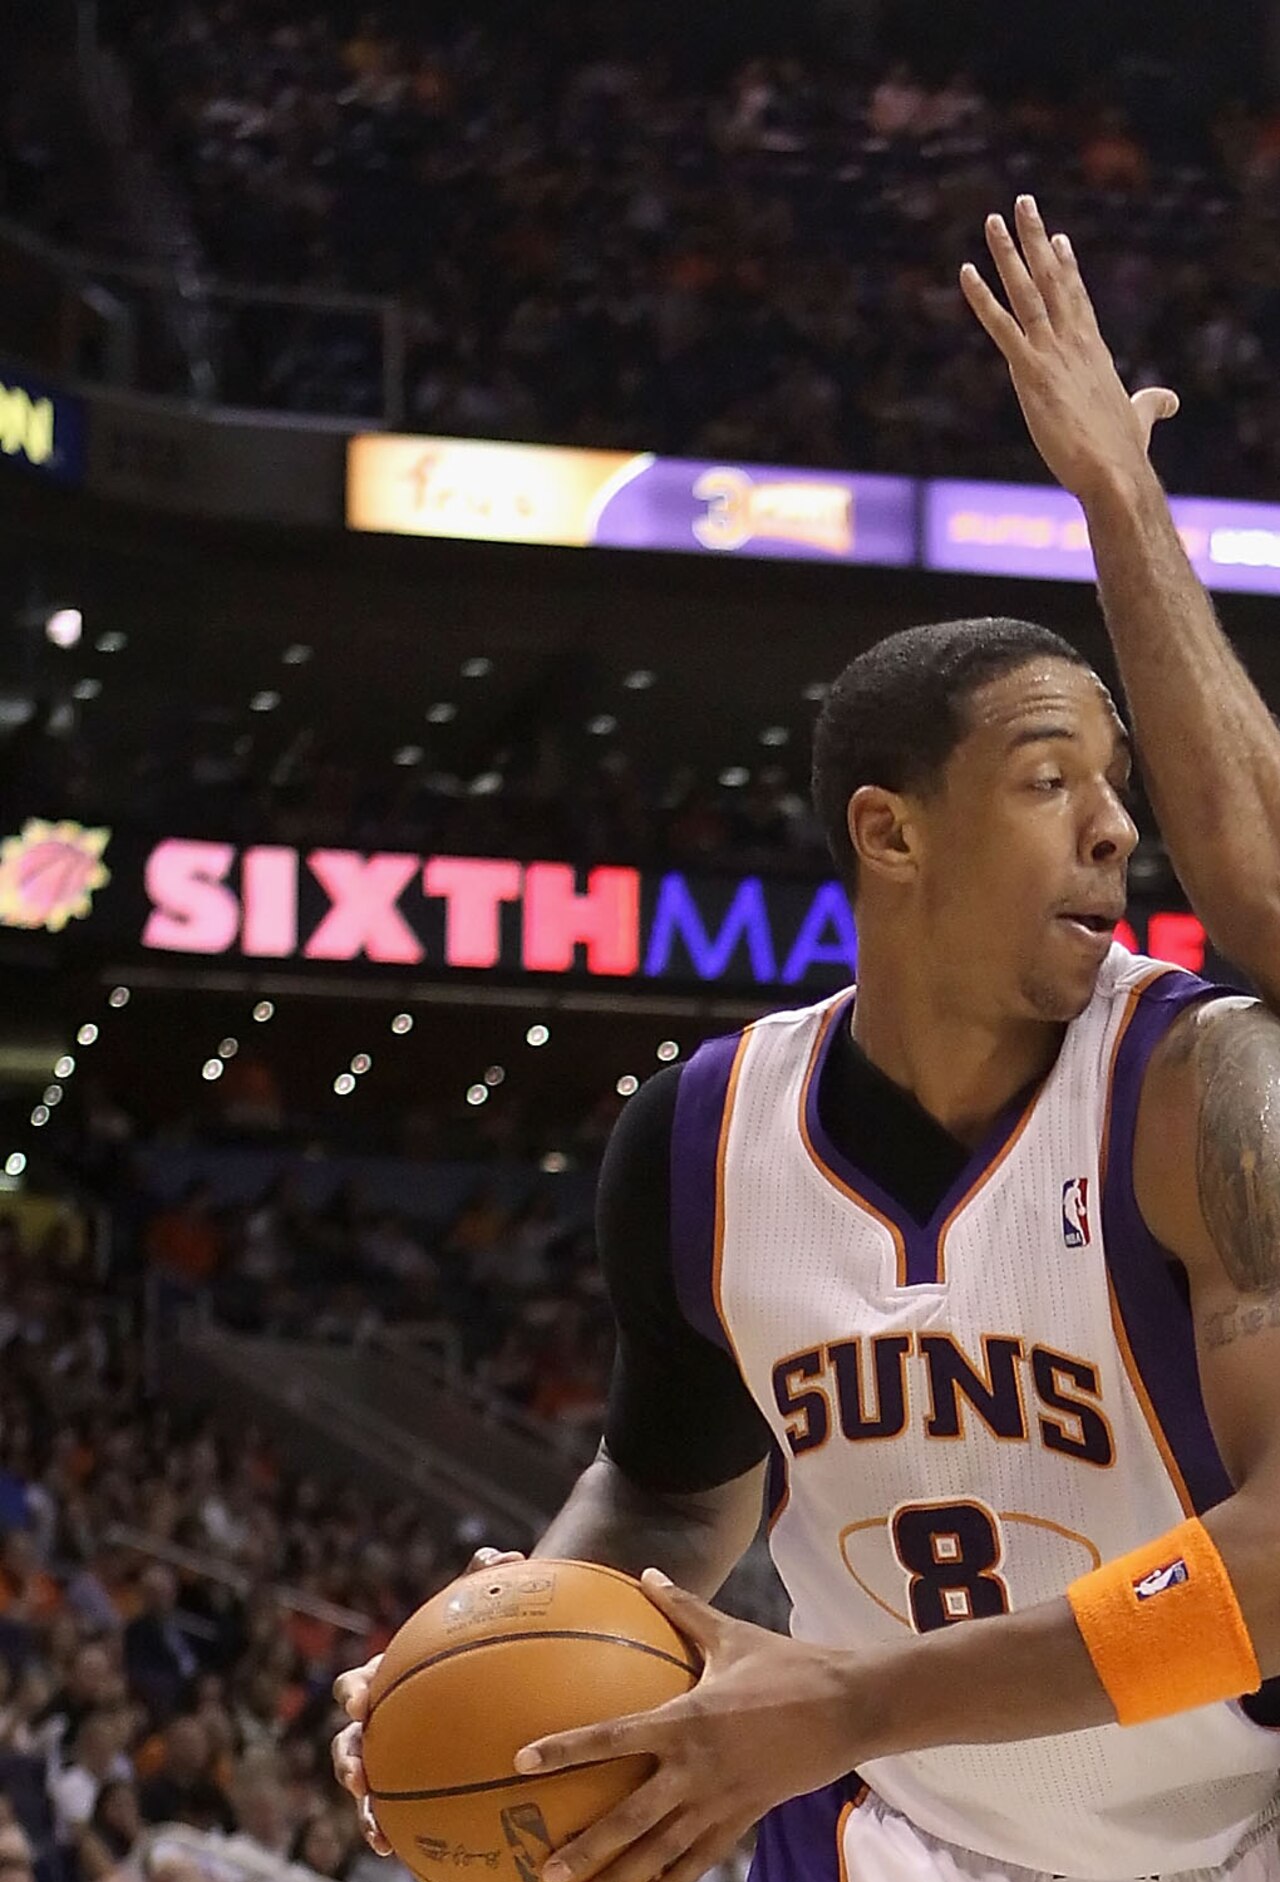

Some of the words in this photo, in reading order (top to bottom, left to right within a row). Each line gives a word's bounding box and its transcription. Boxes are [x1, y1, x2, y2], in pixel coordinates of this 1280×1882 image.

[142, 839, 640, 977] SIXTH
[772, 1331, 1116, 1469] SUNS
[892, 1498, 1012, 1635] 8
